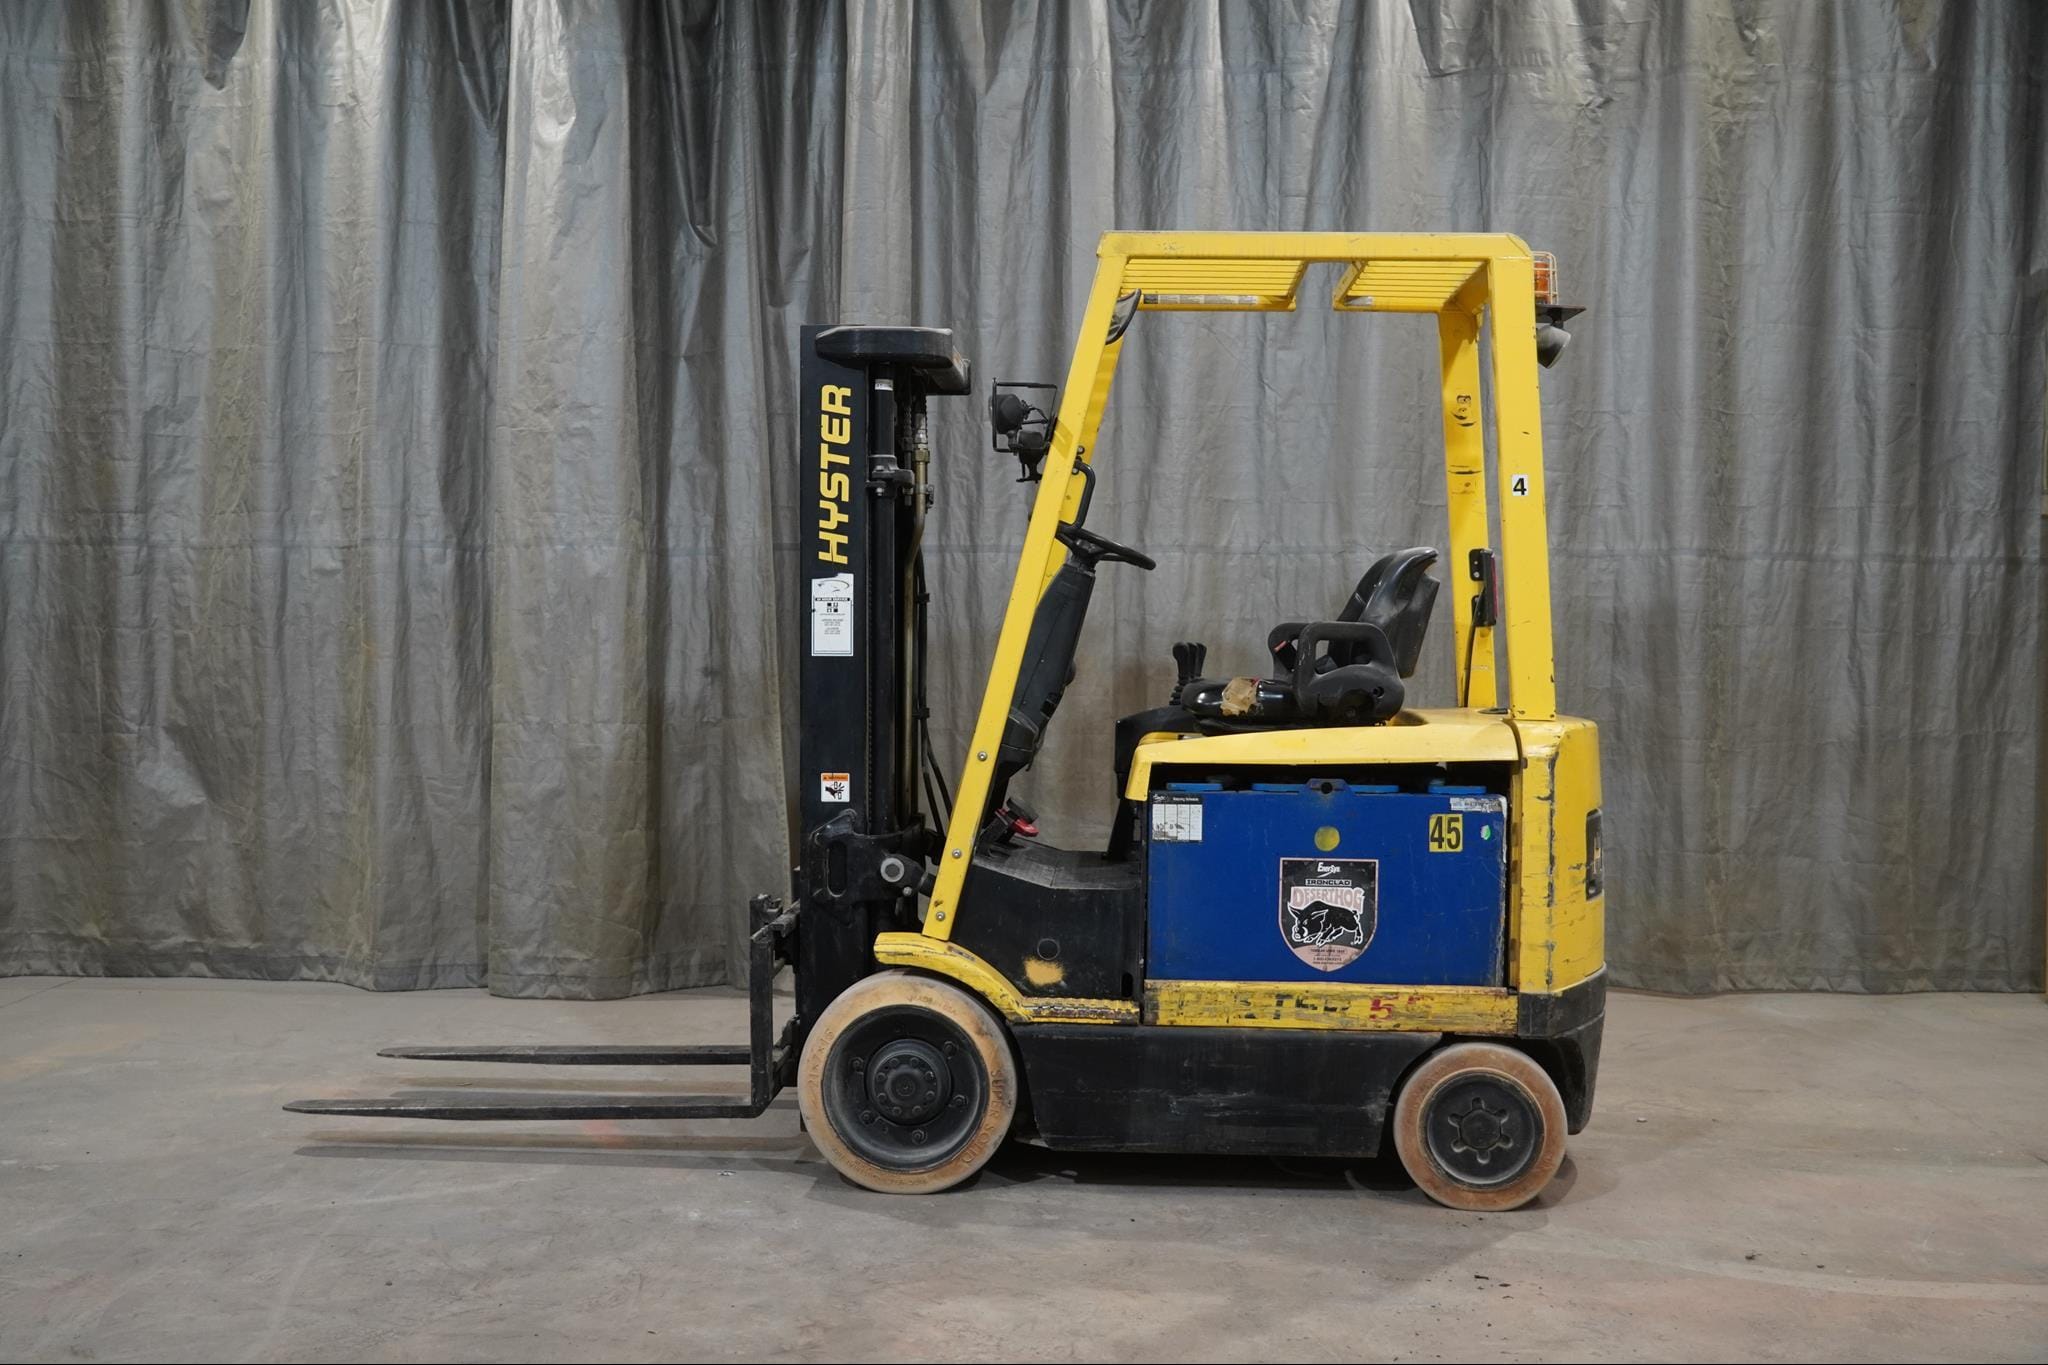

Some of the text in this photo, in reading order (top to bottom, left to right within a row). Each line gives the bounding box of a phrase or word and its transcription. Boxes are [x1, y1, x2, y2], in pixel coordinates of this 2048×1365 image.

[818, 384, 852, 565] HYSTER
[1513, 477, 1527, 496] 4
[1430, 815, 1461, 850] 45
[990, 1069, 1005, 1118] SUPER
